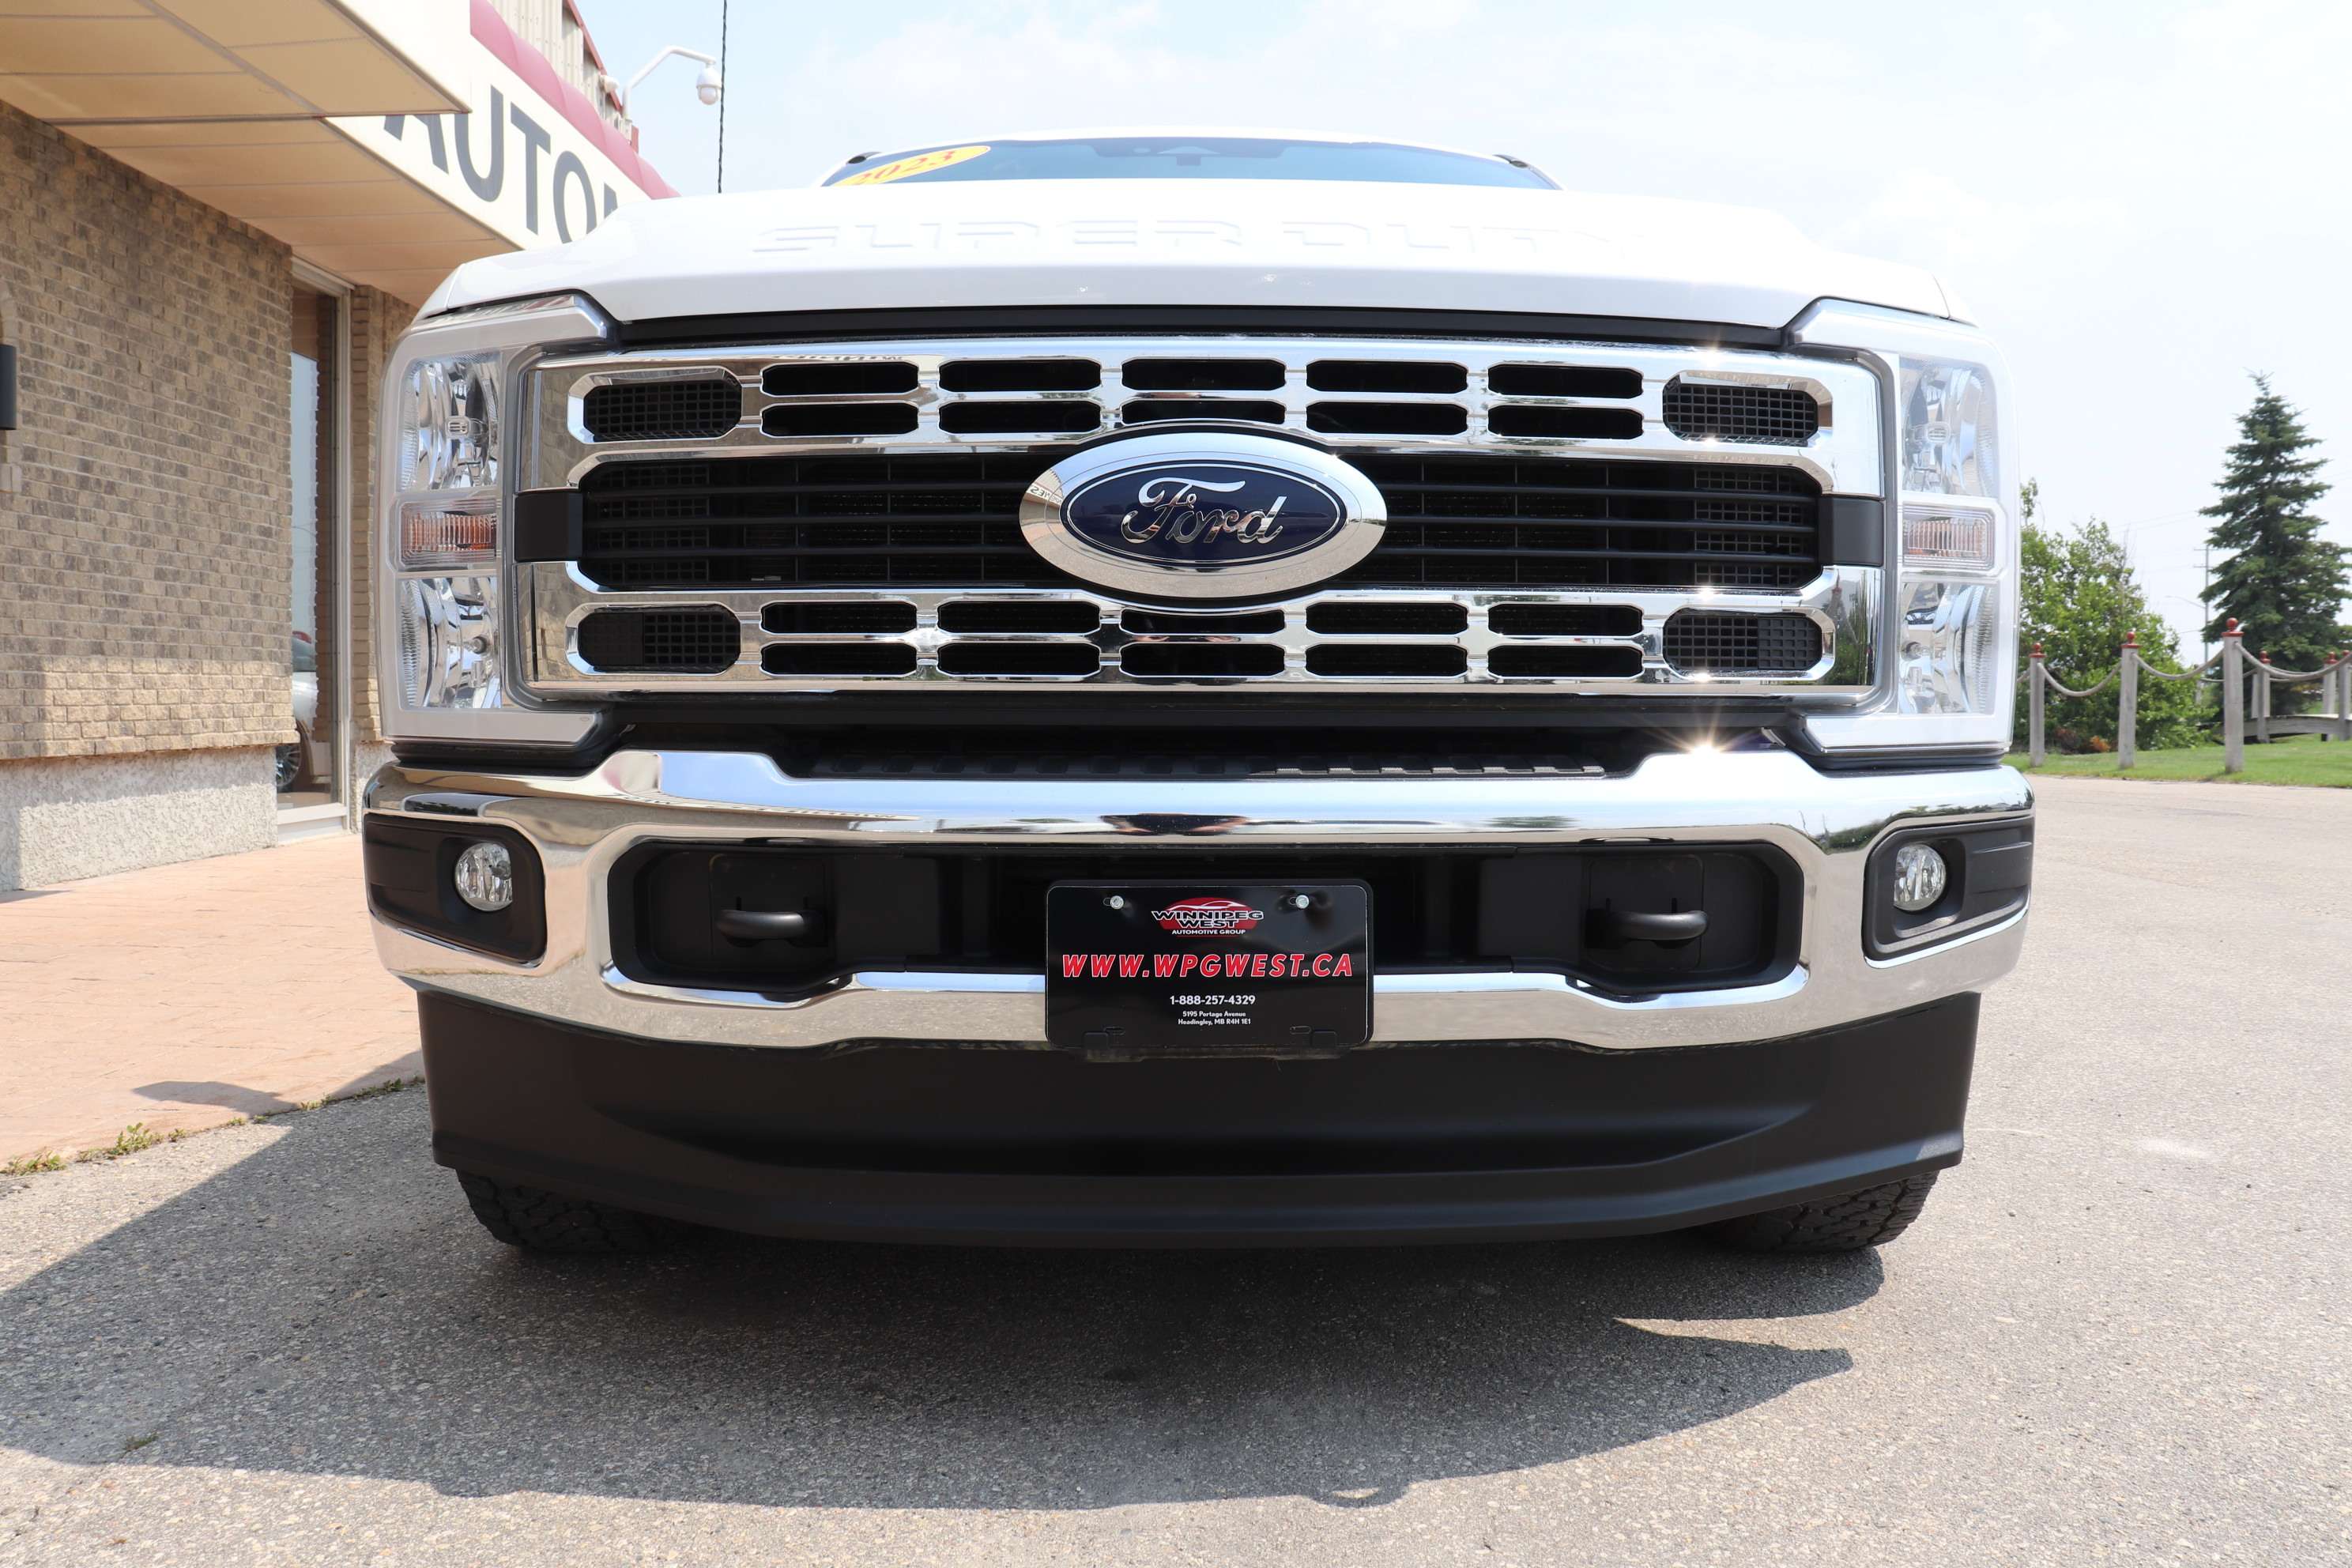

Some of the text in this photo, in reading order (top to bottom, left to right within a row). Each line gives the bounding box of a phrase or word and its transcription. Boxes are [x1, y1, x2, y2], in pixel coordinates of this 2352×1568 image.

[383, 85, 619, 244] UTO
[853, 149, 958, 186] 2023
[752, 220, 1243, 253] SUPER
[1121, 477, 1287, 544] Ford
[1151, 910, 1265, 921] WINNIPEG
[1176, 919, 1239, 929] WEST
[1062, 953, 1353, 978] WWW.WPGWEST.CA
[1170, 995, 1256, 1005] 1-888-257-4329
